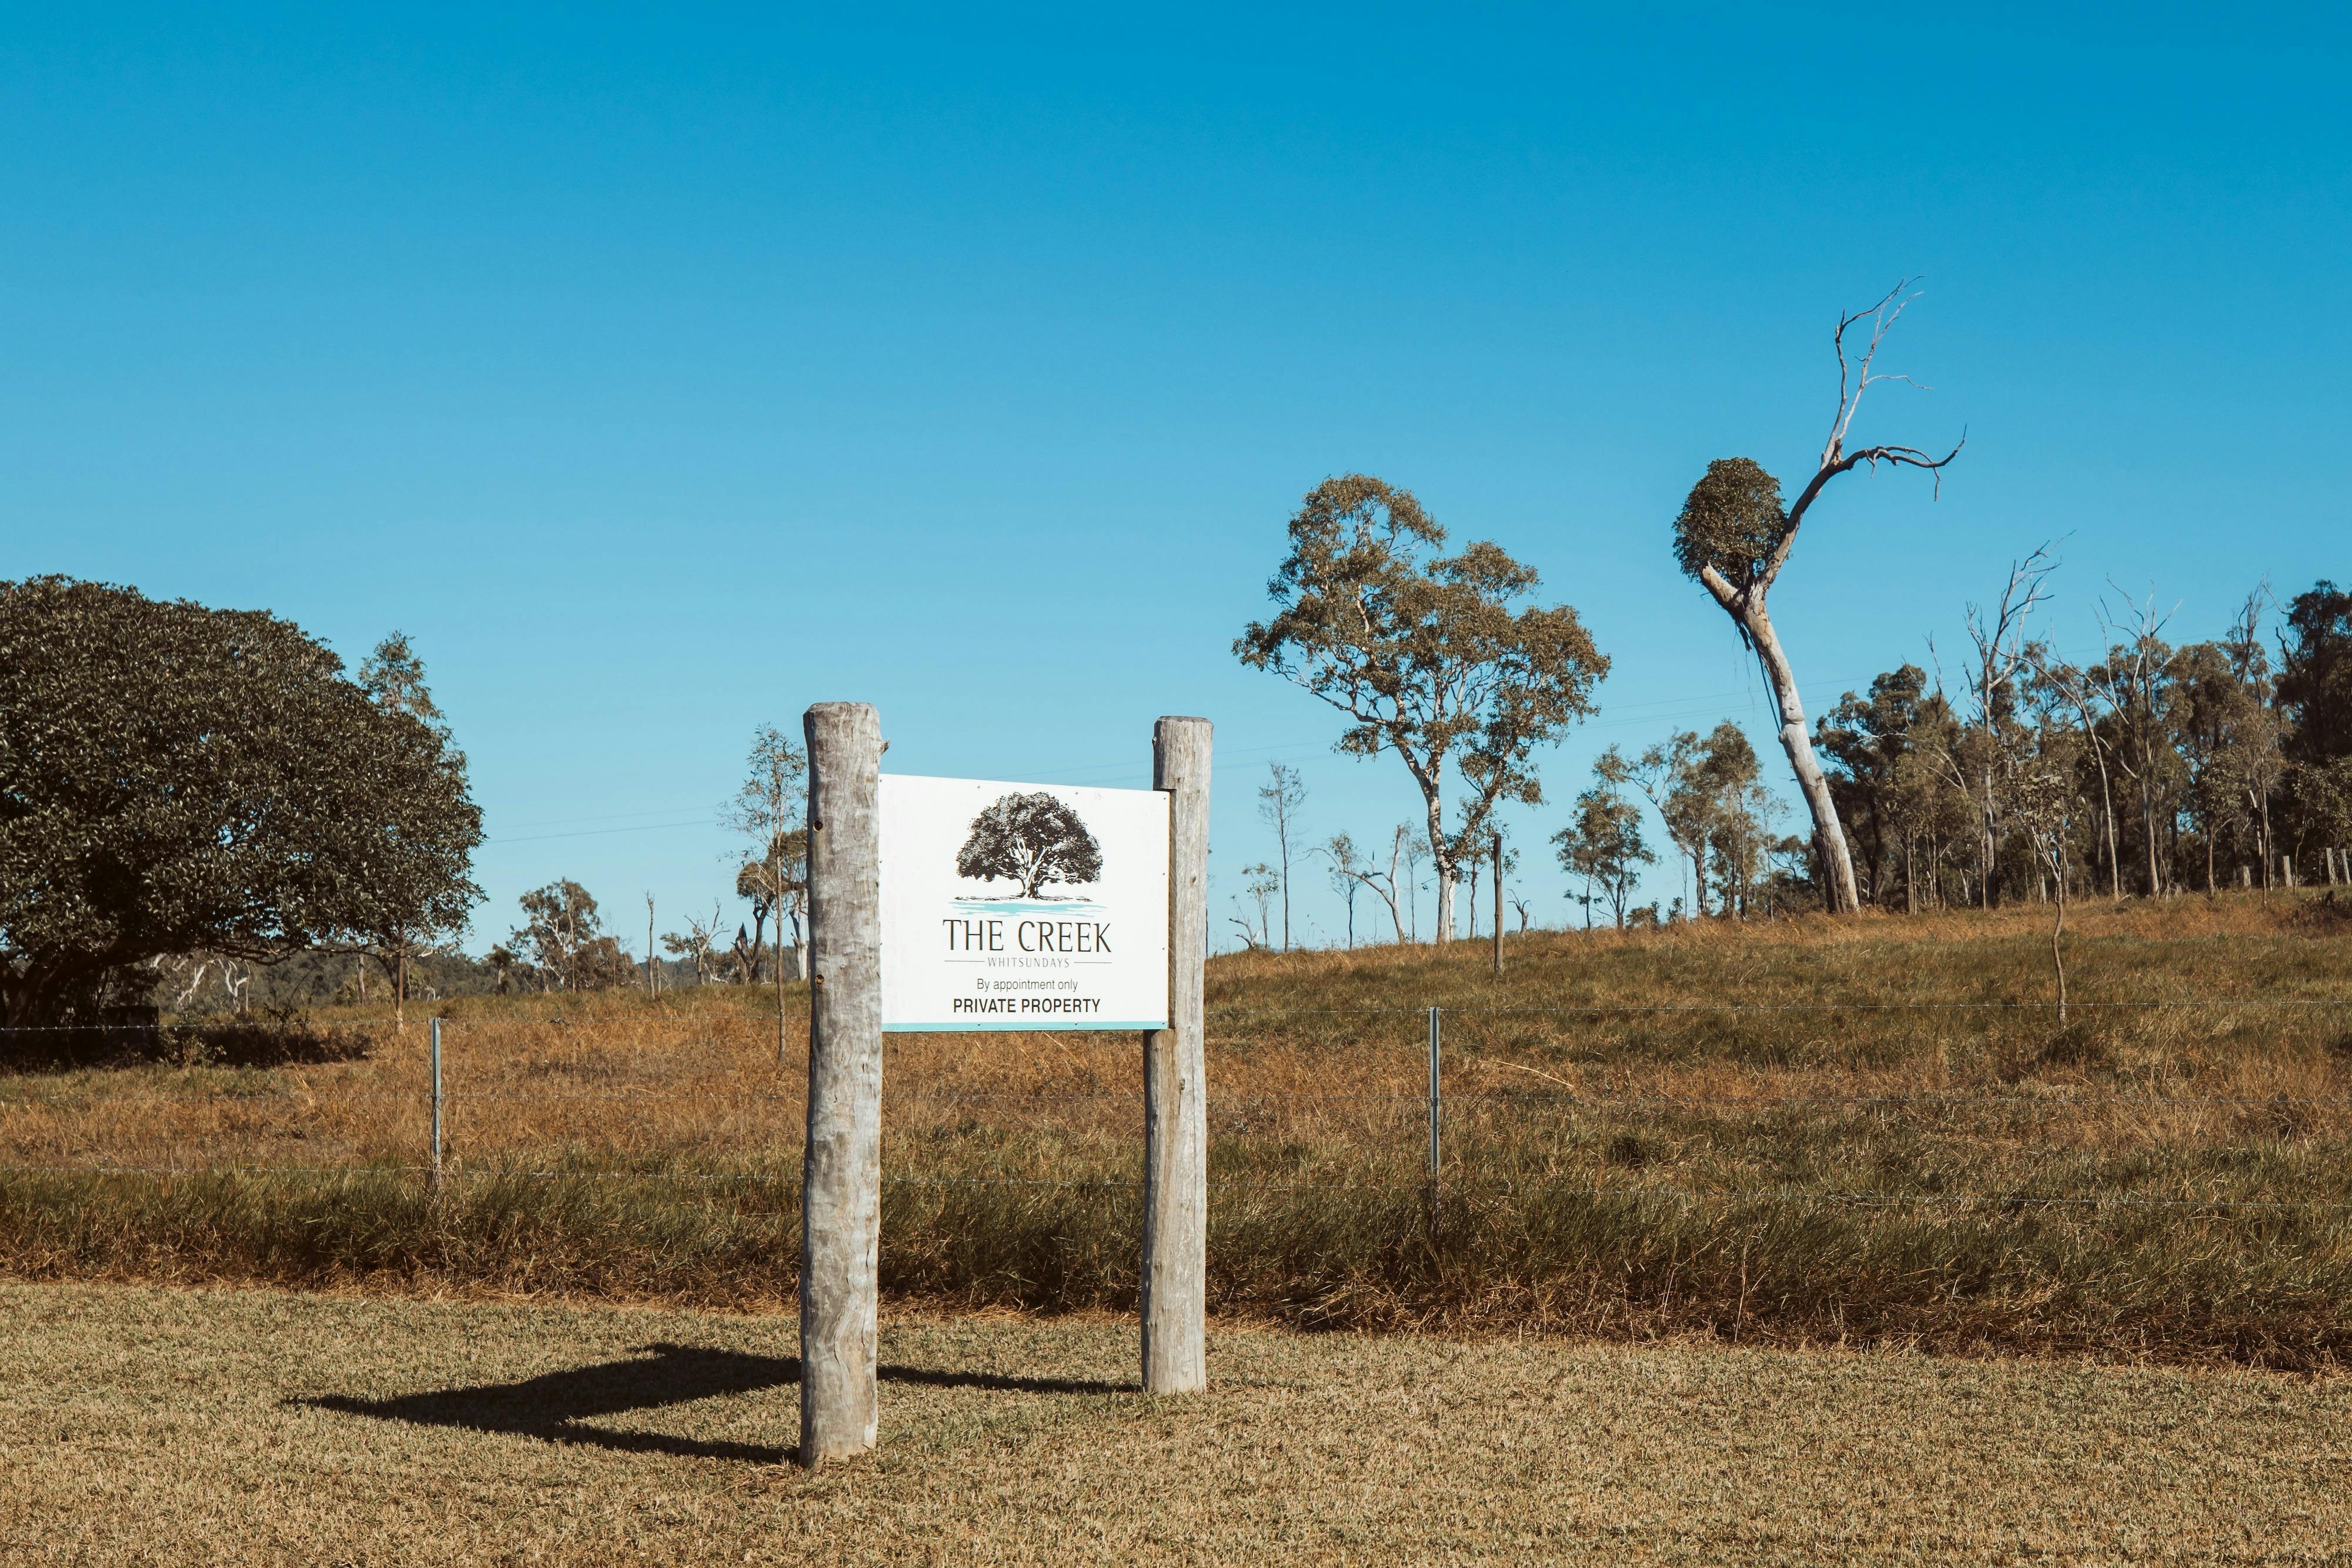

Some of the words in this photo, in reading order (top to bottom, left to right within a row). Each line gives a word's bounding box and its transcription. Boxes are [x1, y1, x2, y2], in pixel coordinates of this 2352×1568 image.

[943, 920, 1004, 951] THE
[1018, 921, 1111, 952] CREEK
[988, 957, 1070, 968] WHITSUNDAYS
[977, 979, 990, 992] By
[994, 979, 1055, 992] appointment
[1058, 979, 1078, 992] only
[953, 998, 1016, 1013] PRIVATE
[1022, 998, 1101, 1013] PROPERTY
